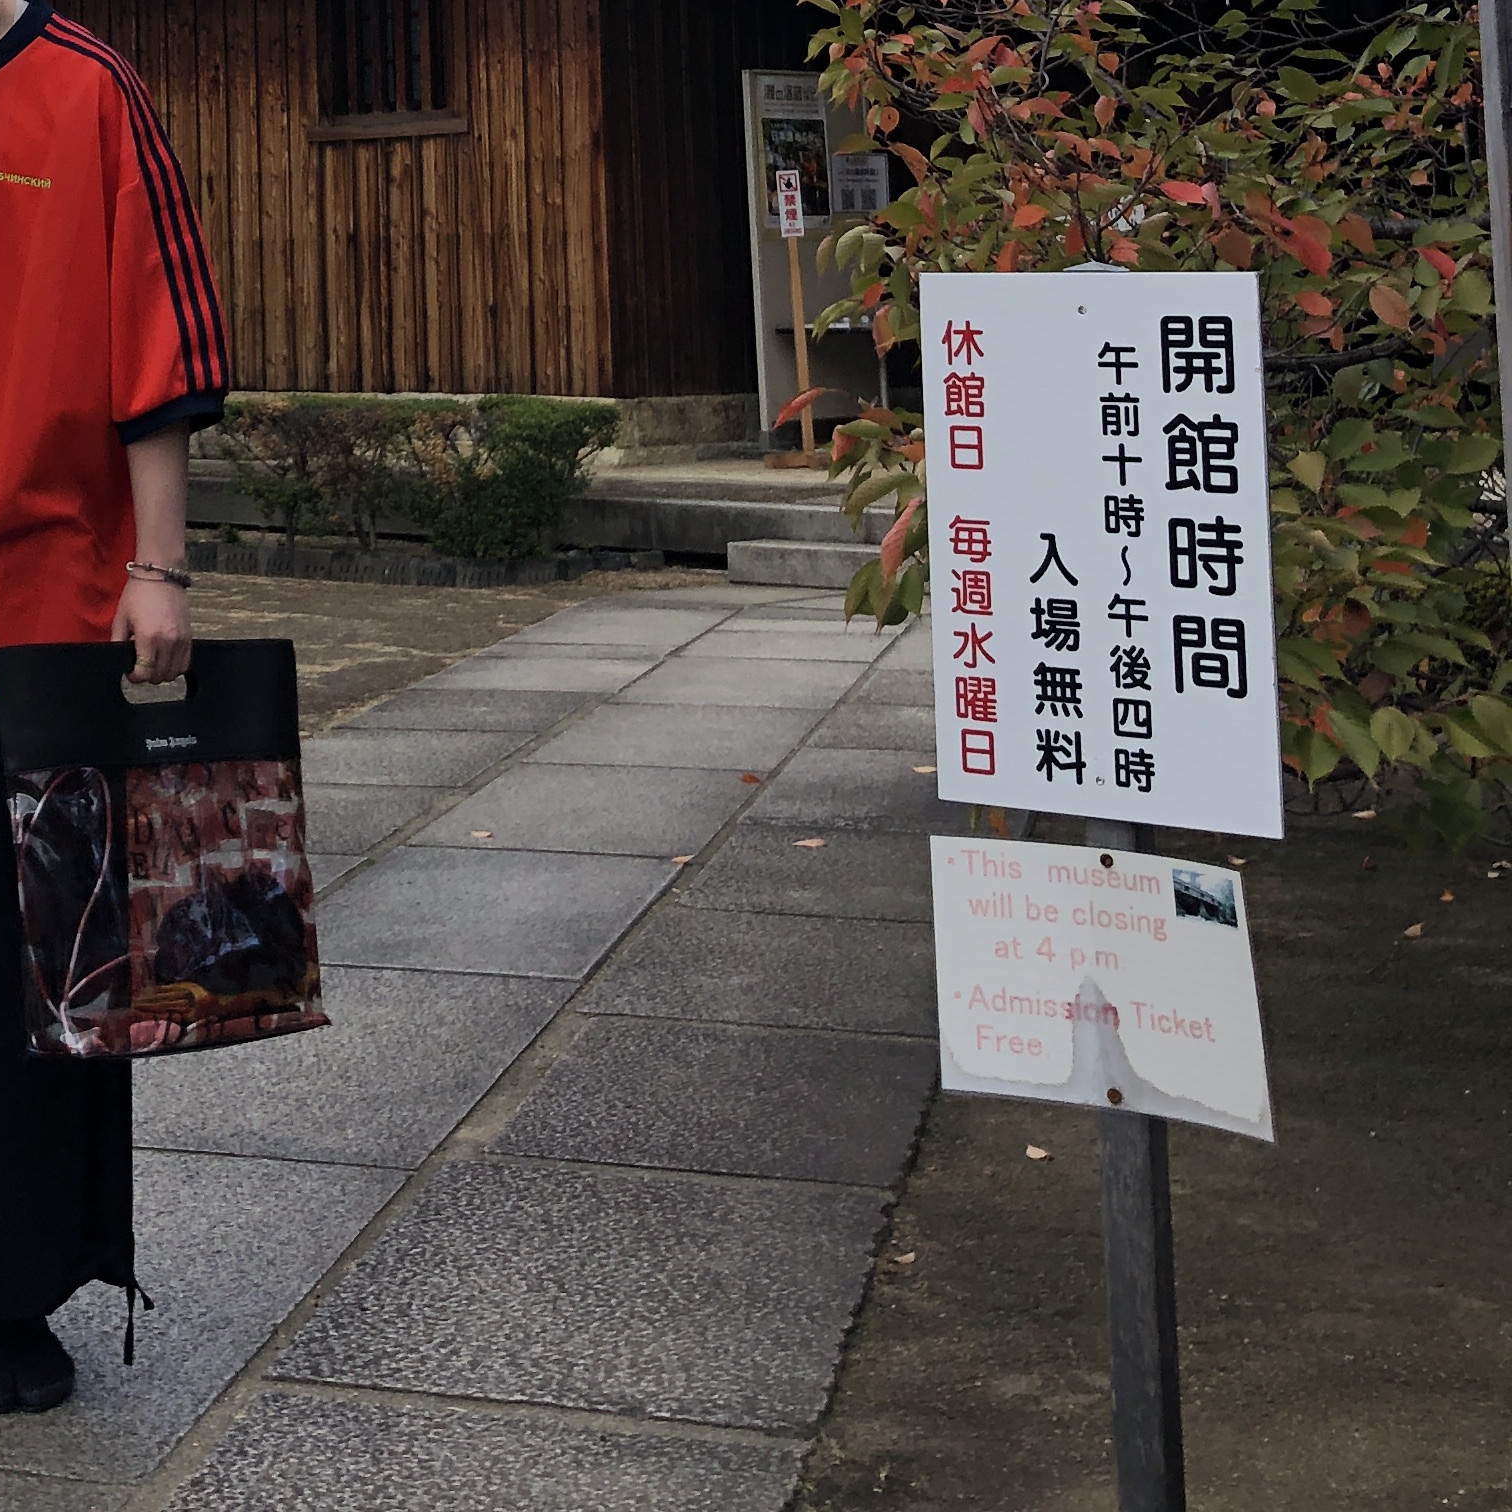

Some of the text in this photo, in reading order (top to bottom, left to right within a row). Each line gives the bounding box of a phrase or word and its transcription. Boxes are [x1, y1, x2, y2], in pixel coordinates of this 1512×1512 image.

[1160, 315, 1248, 699] 開館時間
[941, 320, 998, 776] 休館日 毎週水曜日
[1029, 532, 1087, 785] 入場無料
[960, 849, 1162, 895] This museum
[968, 893, 1168, 942] will be closing
[993, 936, 1024, 961] at
[1035, 935, 1057, 964] 4
[968, 983, 1217, 1043] Admission Ticket
